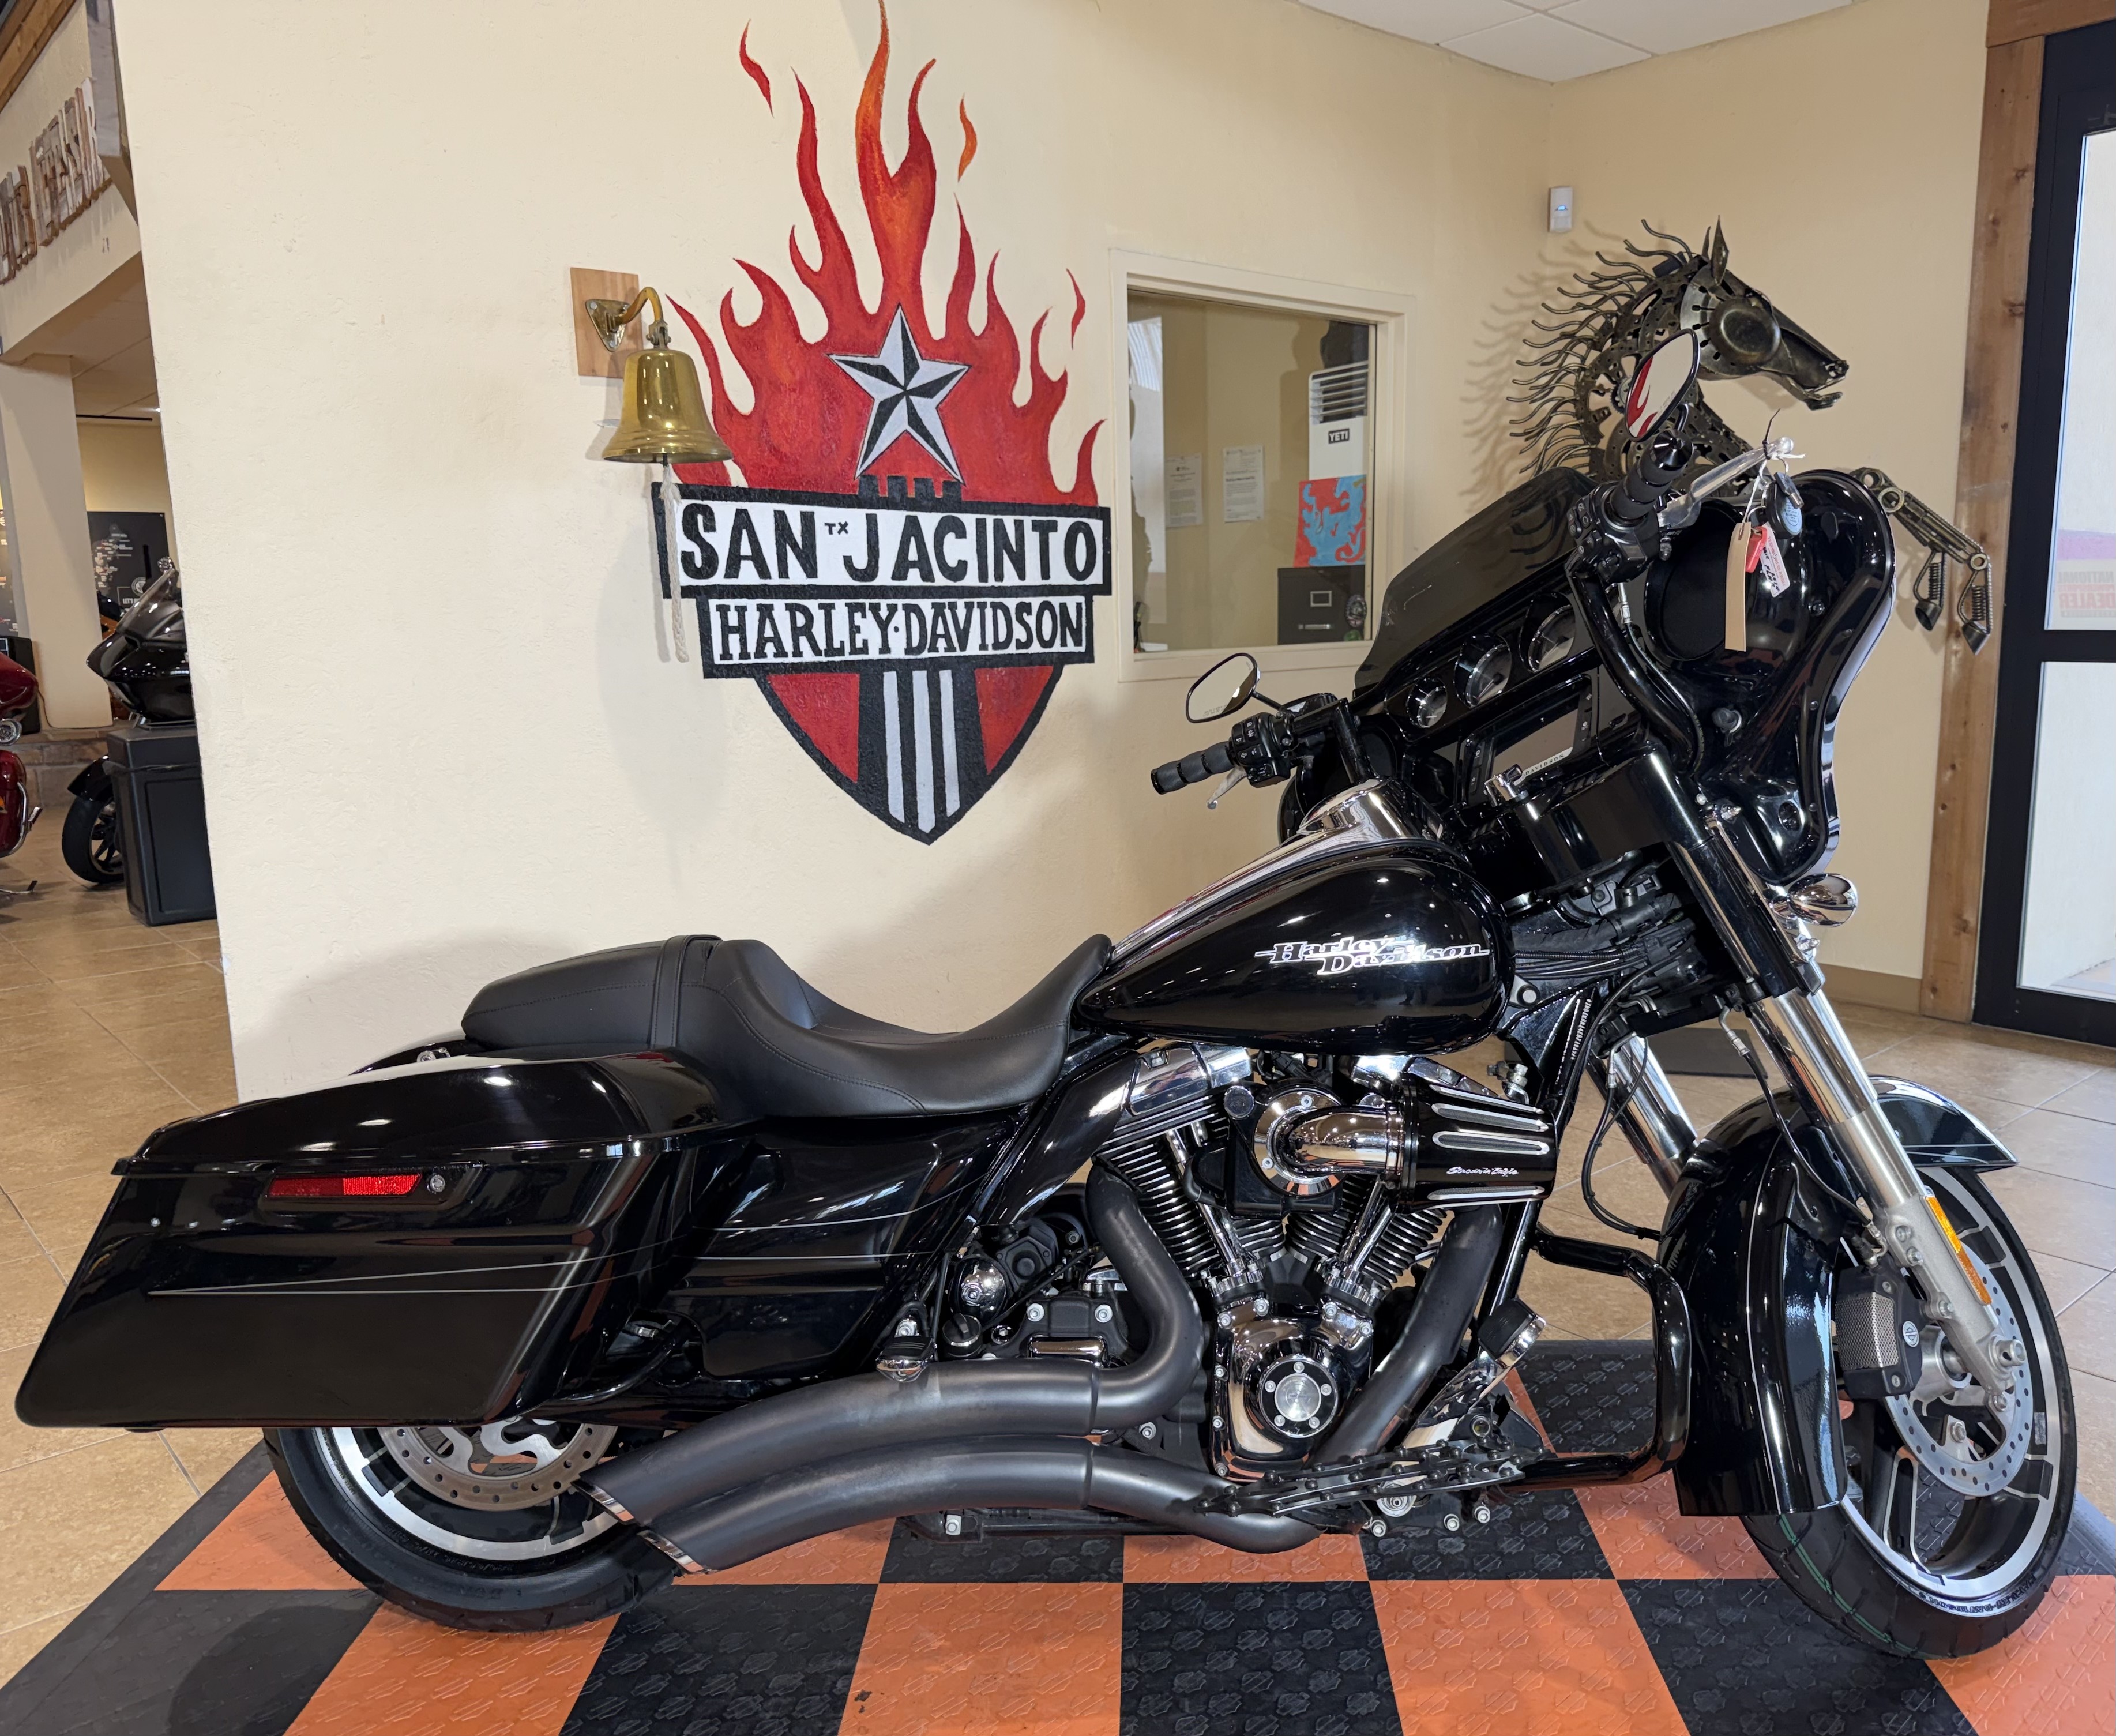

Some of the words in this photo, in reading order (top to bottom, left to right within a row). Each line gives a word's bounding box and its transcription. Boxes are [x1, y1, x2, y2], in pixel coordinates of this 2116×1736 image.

[1329, 430, 1348, 442] YETI
[680, 503, 818, 580] SAN
[825, 521, 849, 536] TX
[843, 513, 1097, 584] JACINTO
[1255, 935, 1415, 964] Harley
[1316, 943, 1490, 976] Davidson
[1491, 1167, 1519, 1177] Eagle
